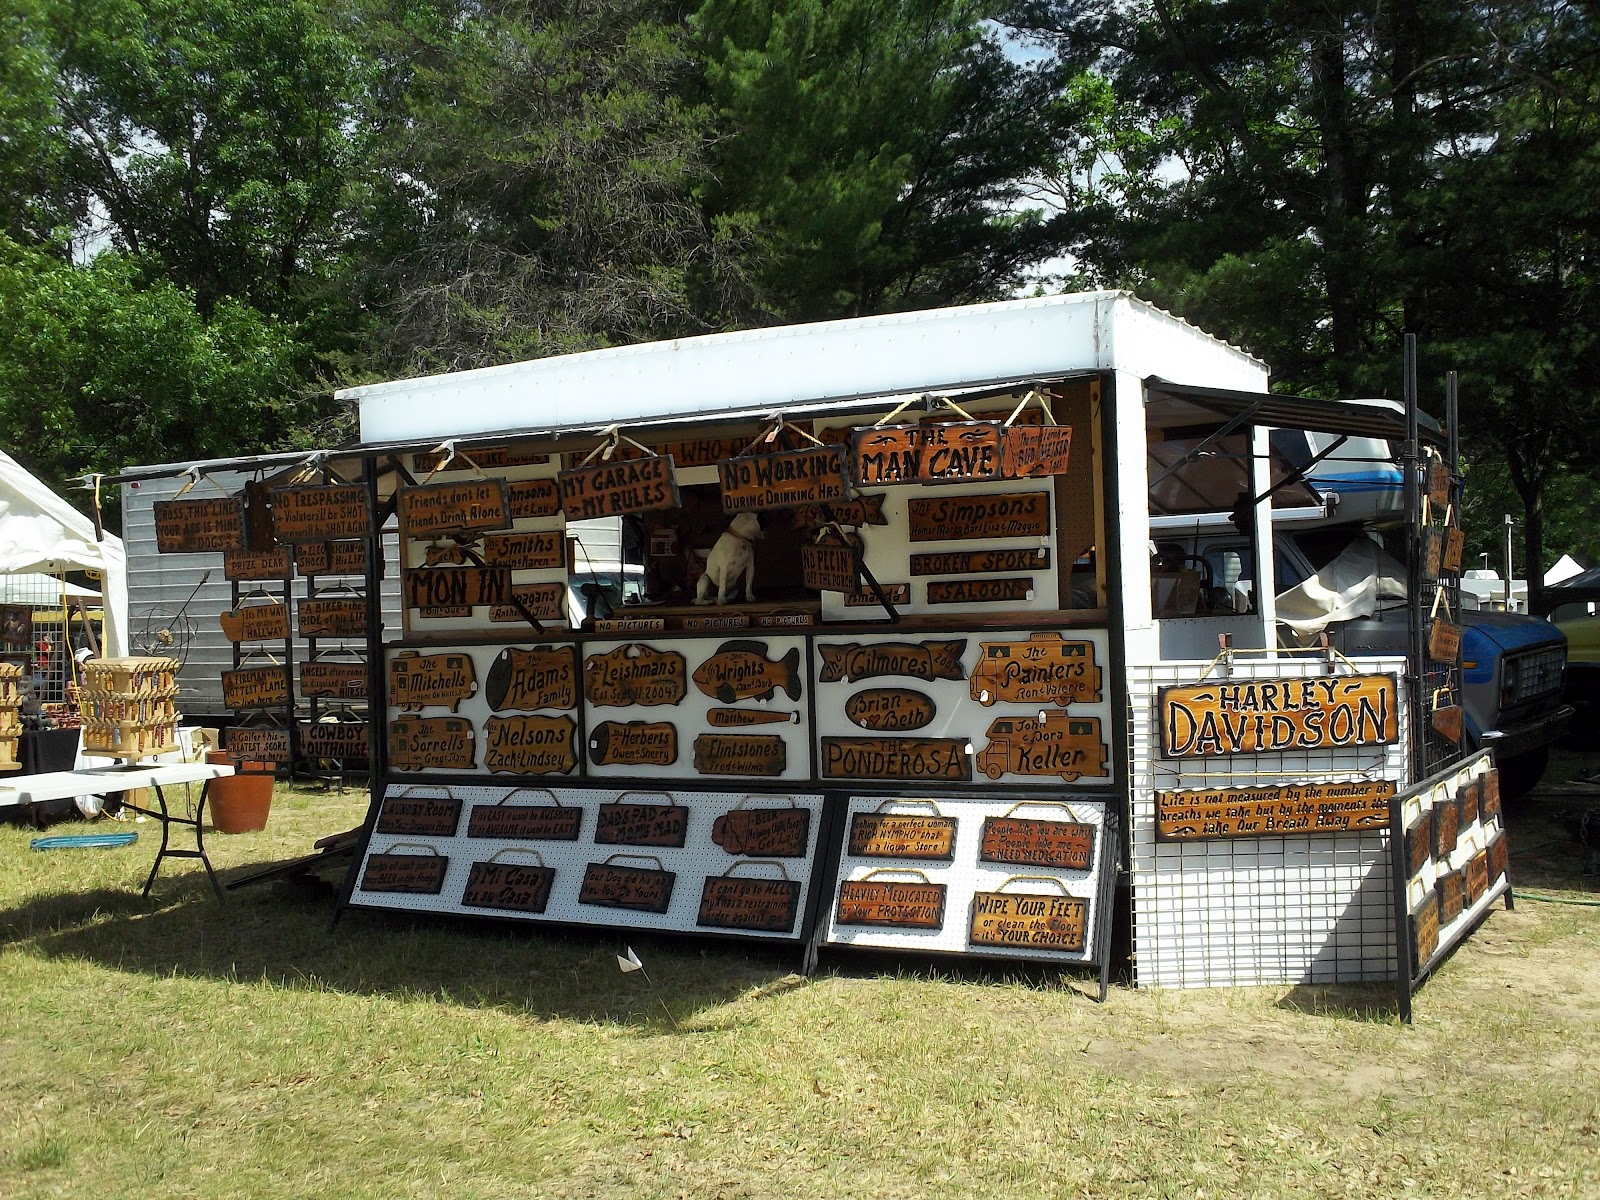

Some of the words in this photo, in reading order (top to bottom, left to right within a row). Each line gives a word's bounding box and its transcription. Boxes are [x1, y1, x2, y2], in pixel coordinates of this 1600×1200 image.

[905, 428, 949, 447] THE
[680, 439, 723, 463] WHO
[862, 450, 922, 484] MAN
[928, 445, 994, 481] CAVE
[562, 475, 586, 498] MY
[591, 459, 663, 492] GARAGE
[450, 487, 473, 502] don't
[476, 486, 490, 499] let
[582, 494, 605, 516] MY
[609, 481, 666, 512] RULES
[188, 505, 208, 519] THIS
[212, 502, 234, 517] LINE
[328, 507, 338, 520] be
[340, 505, 363, 519] SHOT
[931, 497, 1037, 524] Simpsons
[158, 524, 181, 538] YOUR
[203, 521, 212, 534] IS
[216, 518, 238, 533] MINE
[326, 520, 346, 535] SHOT
[1007, 519, 1040, 534] Maggie
[198, 535, 224, 549] DOGS
[498, 534, 553, 557] Smiths
[232, 560, 257, 571] PRIZE
[262, 558, 284, 569] DEAR
[298, 555, 326, 568] SHOCK
[912, 552, 971, 573] BROKEN
[981, 551, 1038, 570] SPOKE
[478, 569, 506, 604] IN
[939, 581, 1016, 600] SALOON
[257, 607, 268, 619] MY
[270, 606, 284, 617] WAY
[304, 603, 312, 614] A
[315, 601, 343, 613] BIKER
[300, 615, 321, 626] RIDE
[599, 622, 611, 631] NO
[617, 620, 660, 631] PICTURES
[687, 620, 699, 629] NO
[704, 618, 745, 629] PICTURES
[247, 626, 283, 638] HALLWAY
[1021, 647, 1048, 659] The
[419, 659, 438, 670] The
[715, 659, 765, 682] Wrights
[851, 649, 928, 676] Gilmores
[235, 670, 268, 685] FIREMAN
[301, 666, 328, 677] ANGELS
[602, 660, 676, 687] Leishmans
[1000, 660, 1085, 689] Painters
[260, 680, 286, 693] FLAME
[409, 670, 466, 693] Mitchells
[511, 664, 569, 707] Adams
[339, 687, 368, 698] NURSES
[536, 683, 571, 706] Family
[645, 686, 672, 700] 2004
[1014, 687, 1038, 700] Ron
[1046, 682, 1086, 696] Valerie
[1218, 678, 1341, 713] HARLEY
[851, 693, 901, 716] Brian
[715, 711, 755, 724] Matthew
[881, 707, 924, 729] Beth
[1167, 686, 1389, 757] DAVIDSON
[267, 730, 278, 741] his
[309, 724, 364, 741] COWBOY
[418, 723, 435, 735] The
[491, 720, 566, 747] Nelsons
[621, 728, 670, 746] Herberts
[409, 733, 464, 752] Sorrells
[1029, 731, 1063, 744] Dora
[227, 742, 260, 753] GREATEST
[263, 741, 287, 752] SCORE
[307, 741, 368, 757] OUTHOUSE
[706, 738, 779, 759] Flintstones
[879, 740, 906, 752] THE
[255, 751, 267, 760] live
[268, 751, 284, 760] here
[424, 752, 443, 765] Greg
[519, 749, 565, 770] Lindsey
[612, 747, 636, 759] Owen
[640, 747, 669, 763] Sherry
[827, 742, 963, 776] PONDEROSA
[1016, 743, 1084, 773] Keller
[709, 758, 731, 773] Fred
[737, 760, 764, 772] Wilma
[1160, 793, 1185, 808] Life
[1189, 793, 1201, 806] is
[1203, 792, 1224, 805] not
[1226, 789, 1281, 804] measured
[1285, 787, 1300, 804] by
[1304, 786, 1323, 800] the
[1326, 784, 1371, 798] number
[1376, 782, 1390, 796] of
[487, 809, 506, 821] EASY
[539, 809, 575, 821] AWESOME
[755, 811, 778, 825] BEER
[1160, 809, 1202, 824] breaths
[1205, 809, 1221, 820] we
[1226, 805, 1251, 820] take
[1255, 804, 1275, 817] but
[1278, 802, 1293, 819] by
[1295, 801, 1315, 815] the
[1316, 799, 1367, 813] moments
[552, 823, 576, 835] EASY
[879, 818, 889, 829] for
[898, 818, 925, 830] perfect
[1202, 820, 1230, 837] take
[1237, 819, 1260, 832] Our
[1265, 816, 1309, 832] Breath
[1314, 815, 1350, 832] Away
[758, 836, 775, 850] Get
[779, 829, 800, 844] Laid
[857, 829, 878, 840] RICH
[880, 829, 918, 840] NYMPHO
[920, 830, 941, 840] that
[1052, 827, 1067, 836] are
[1070, 828, 1092, 841] why
[852, 843, 872, 851] owns
[883, 841, 911, 855] liquor
[999, 835, 1030, 850] People
[1056, 840, 1072, 850] me
[996, 848, 1021, 861] NEED
[1022, 849, 1087, 863] MEDICATION
[504, 867, 540, 887] Casa
[587, 869, 604, 881] Your
[605, 871, 622, 885] Dog
[624, 873, 639, 884] did
[638, 873, 650, 885] his
[496, 886, 532, 905] Casa
[708, 881, 717, 894] I
[718, 882, 738, 894] can't
[739, 886, 751, 898] go
[752, 883, 763, 895] to
[765, 882, 792, 896] HELL
[720, 898, 735, 909] has
[743, 898, 790, 913] restraining
[853, 902, 872, 916] Your
[877, 904, 940, 919] PROTECTION
[976, 895, 1010, 916] WIPE
[1014, 897, 1047, 917] YOUR
[1047, 897, 1084, 919] FEET
[705, 910, 730, 921] order
[732, 911, 766, 925] against
[983, 918, 994, 928] or
[997, 918, 1025, 929] clean
[1029, 918, 1046, 930] the
[981, 929, 996, 941] it's
[1000, 930, 1031, 943] YOUR
[1031, 930, 1077, 945] CHOICE
